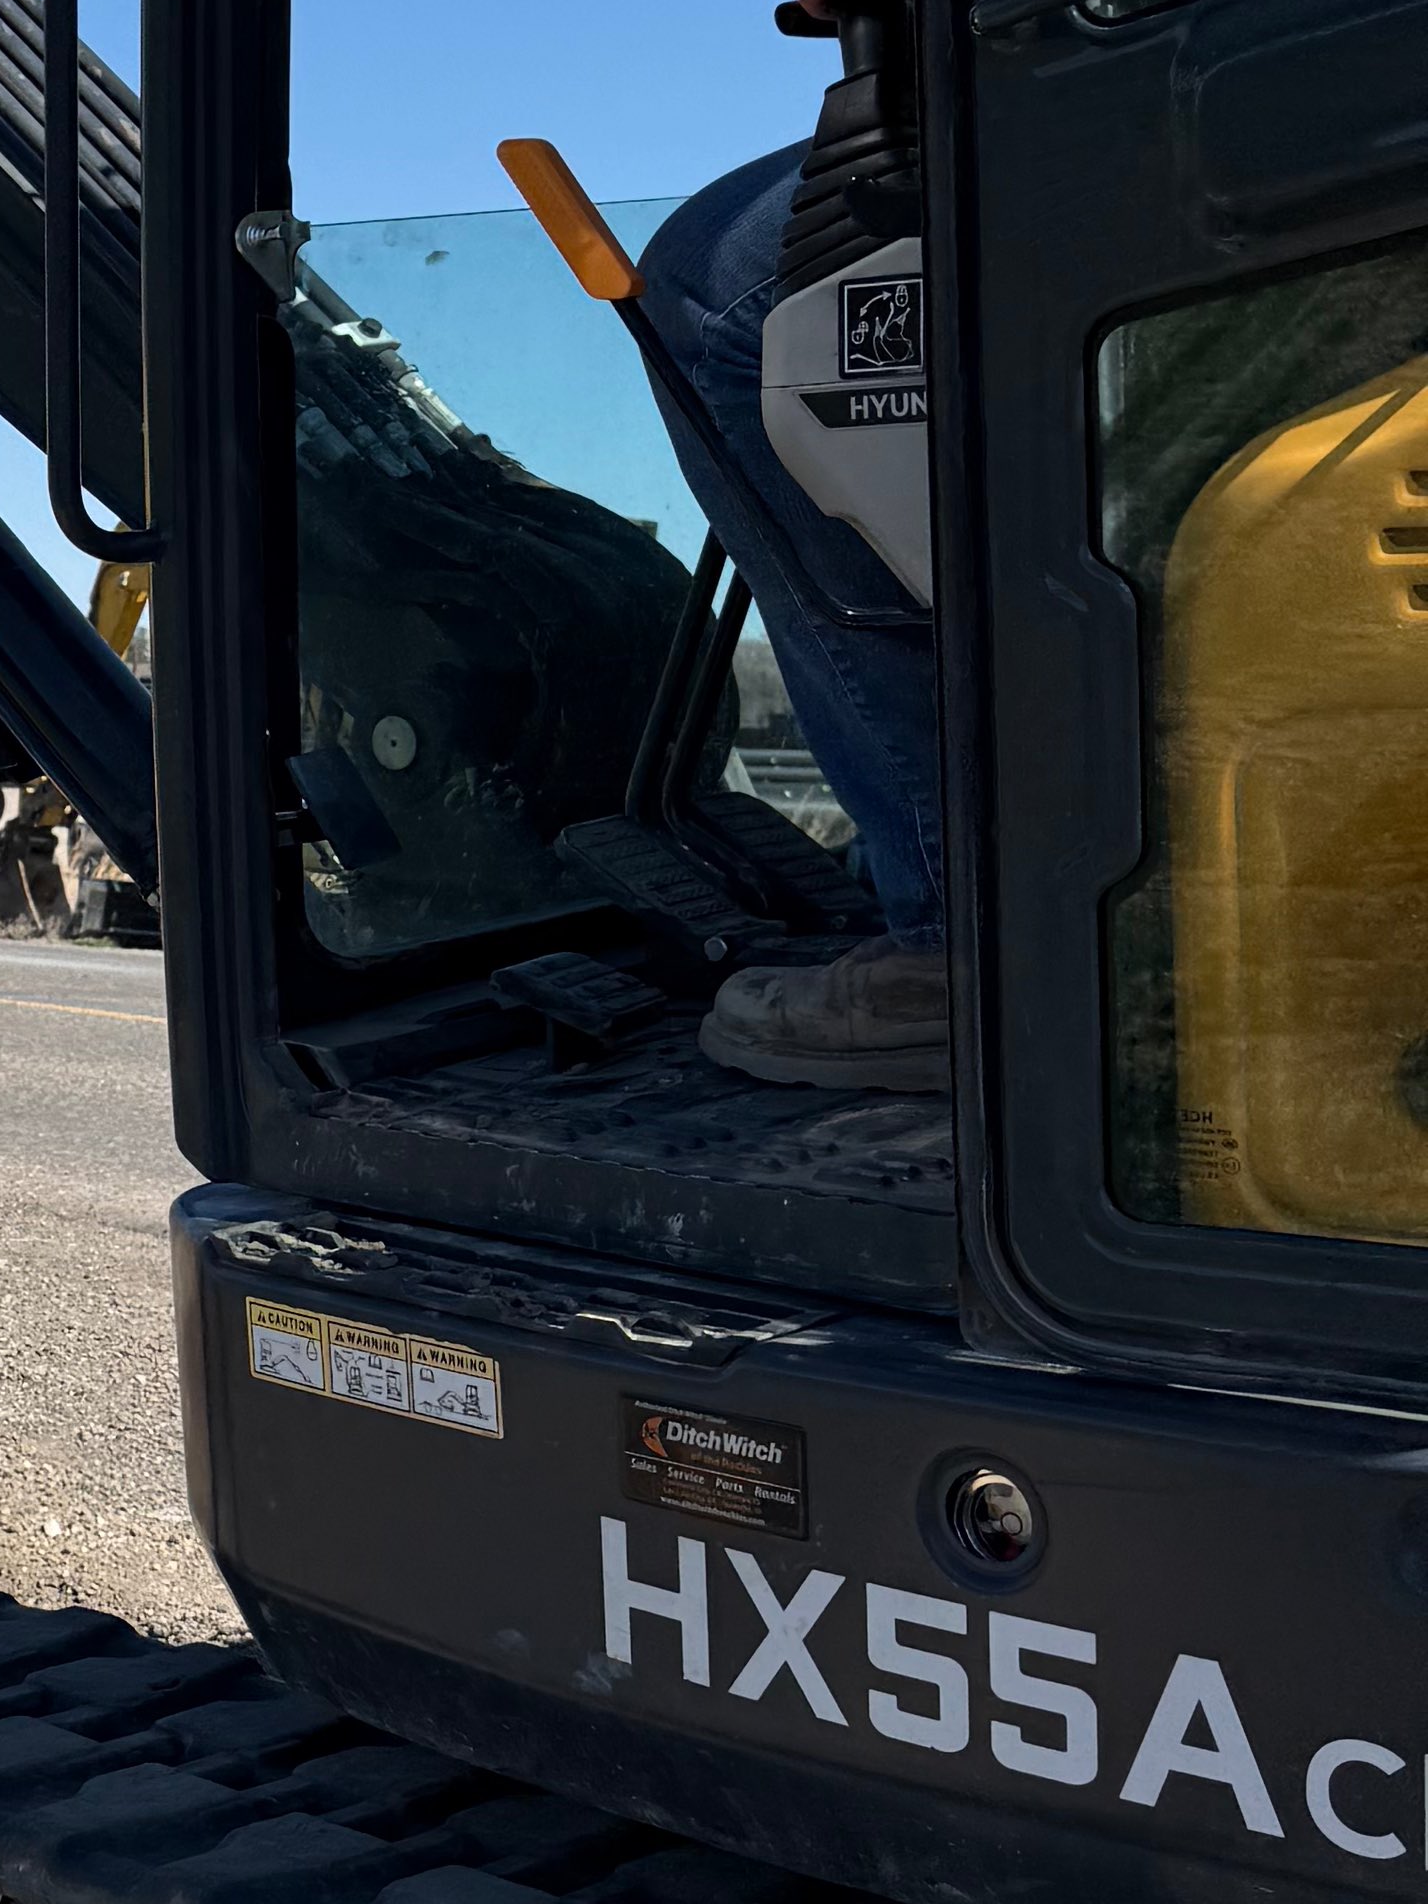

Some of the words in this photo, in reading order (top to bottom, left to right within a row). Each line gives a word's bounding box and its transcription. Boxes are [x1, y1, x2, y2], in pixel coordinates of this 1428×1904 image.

[267, 1313, 314, 1335] CAUTION
[346, 1331, 399, 1355] WARNING
[429, 1349, 487, 1375] WARNING
[630, 1457, 658, 1474] Sales
[667, 1466, 706, 1485] Service
[715, 1478, 744, 1494] Parts
[754, 1486, 797, 1505] Rentals
